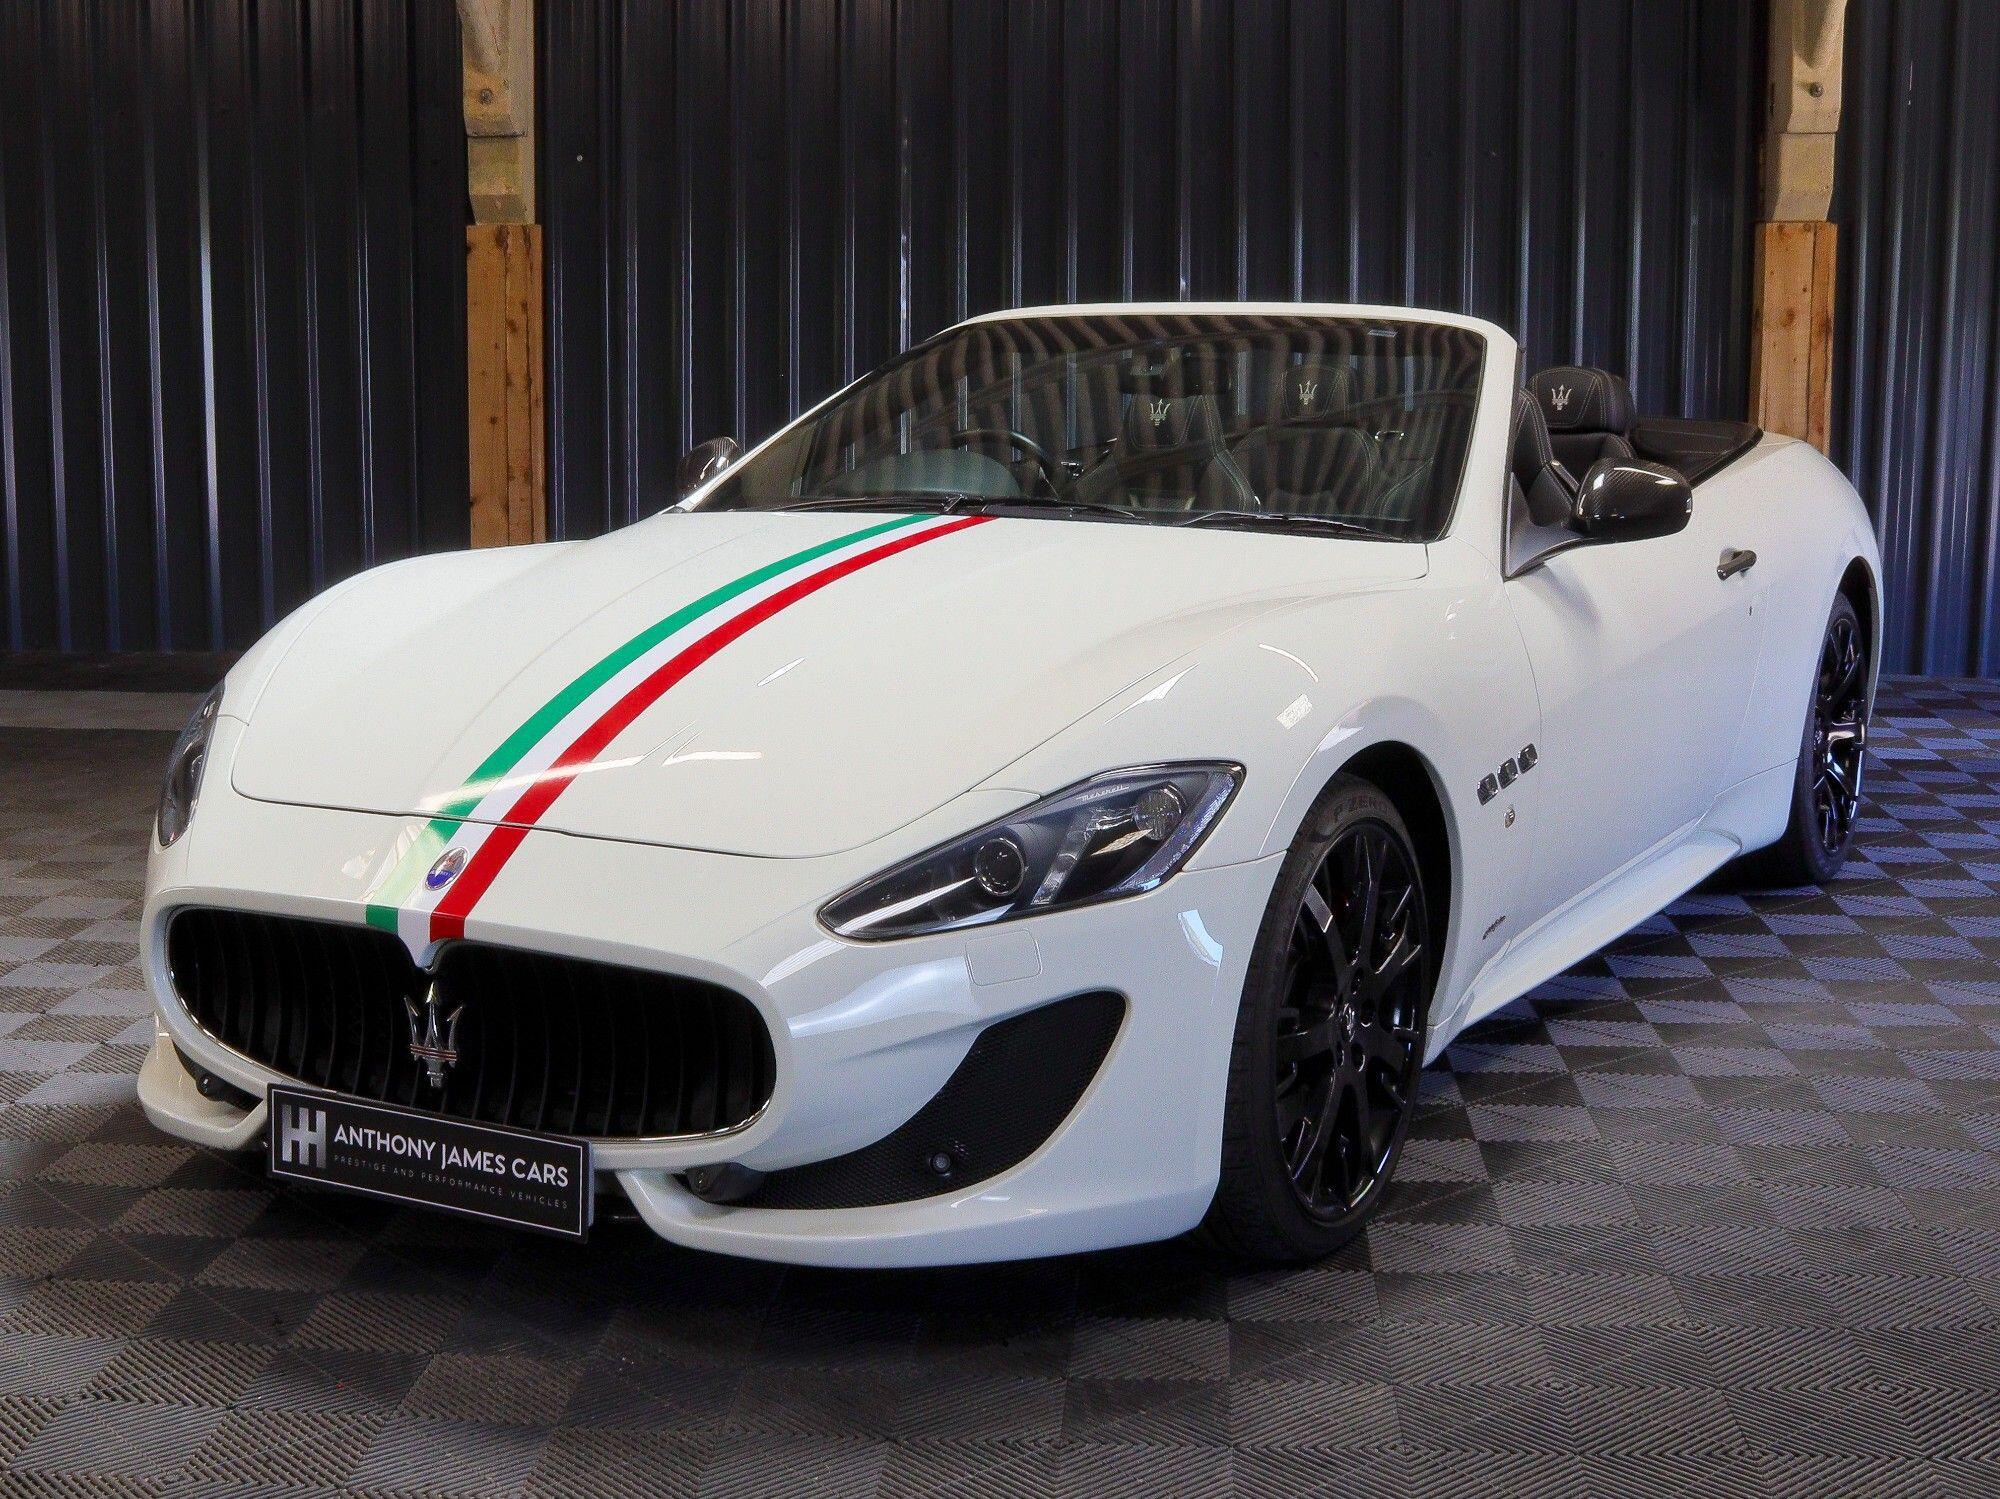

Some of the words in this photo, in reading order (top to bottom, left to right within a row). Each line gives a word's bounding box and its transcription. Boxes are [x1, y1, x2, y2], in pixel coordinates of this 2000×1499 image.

[334, 1123, 437, 1161] ANTHONY
[441, 1143, 506, 1175] JAMES
[511, 1157, 569, 1188] CARS
[334, 1154, 387, 1172] PRESTIGE
[393, 1167, 414, 1178] AND
[421, 1172, 503, 1196] PERFORMANCE
[510, 1191, 568, 1209] VEHICLES
